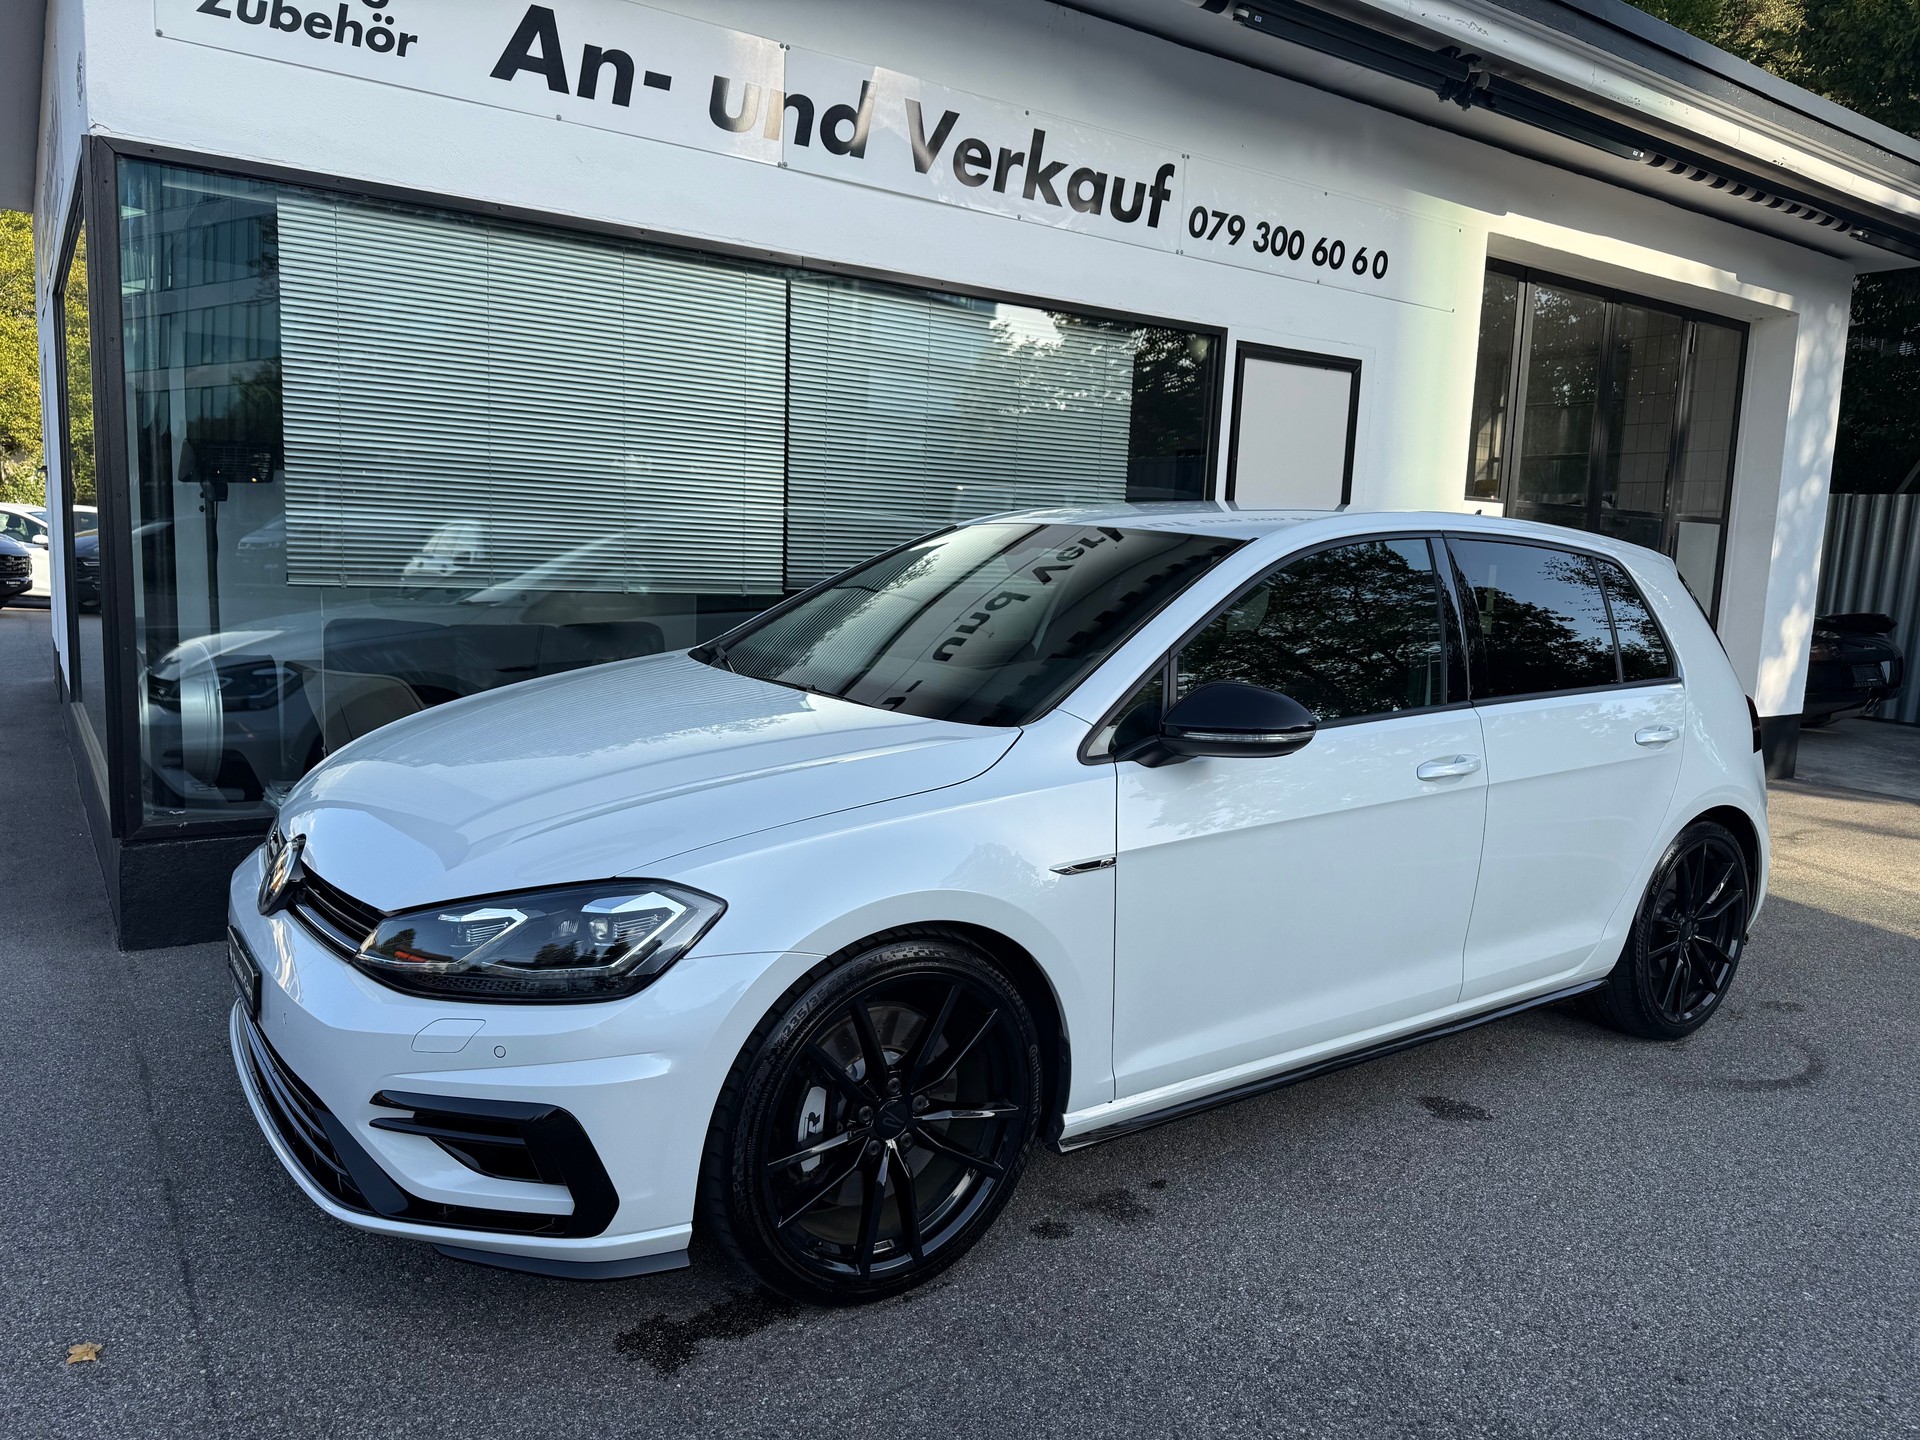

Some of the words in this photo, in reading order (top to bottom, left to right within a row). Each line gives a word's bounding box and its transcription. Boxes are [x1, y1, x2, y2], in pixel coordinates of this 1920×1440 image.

[490, 4, 672, 107] An-
[709, 75, 877, 159] und
[904, 98, 1175, 229] Verkauf
[1188, 205, 1246, 246] 079
[1252, 221, 1305, 261] 300
[1311, 237, 1346, 270] 60
